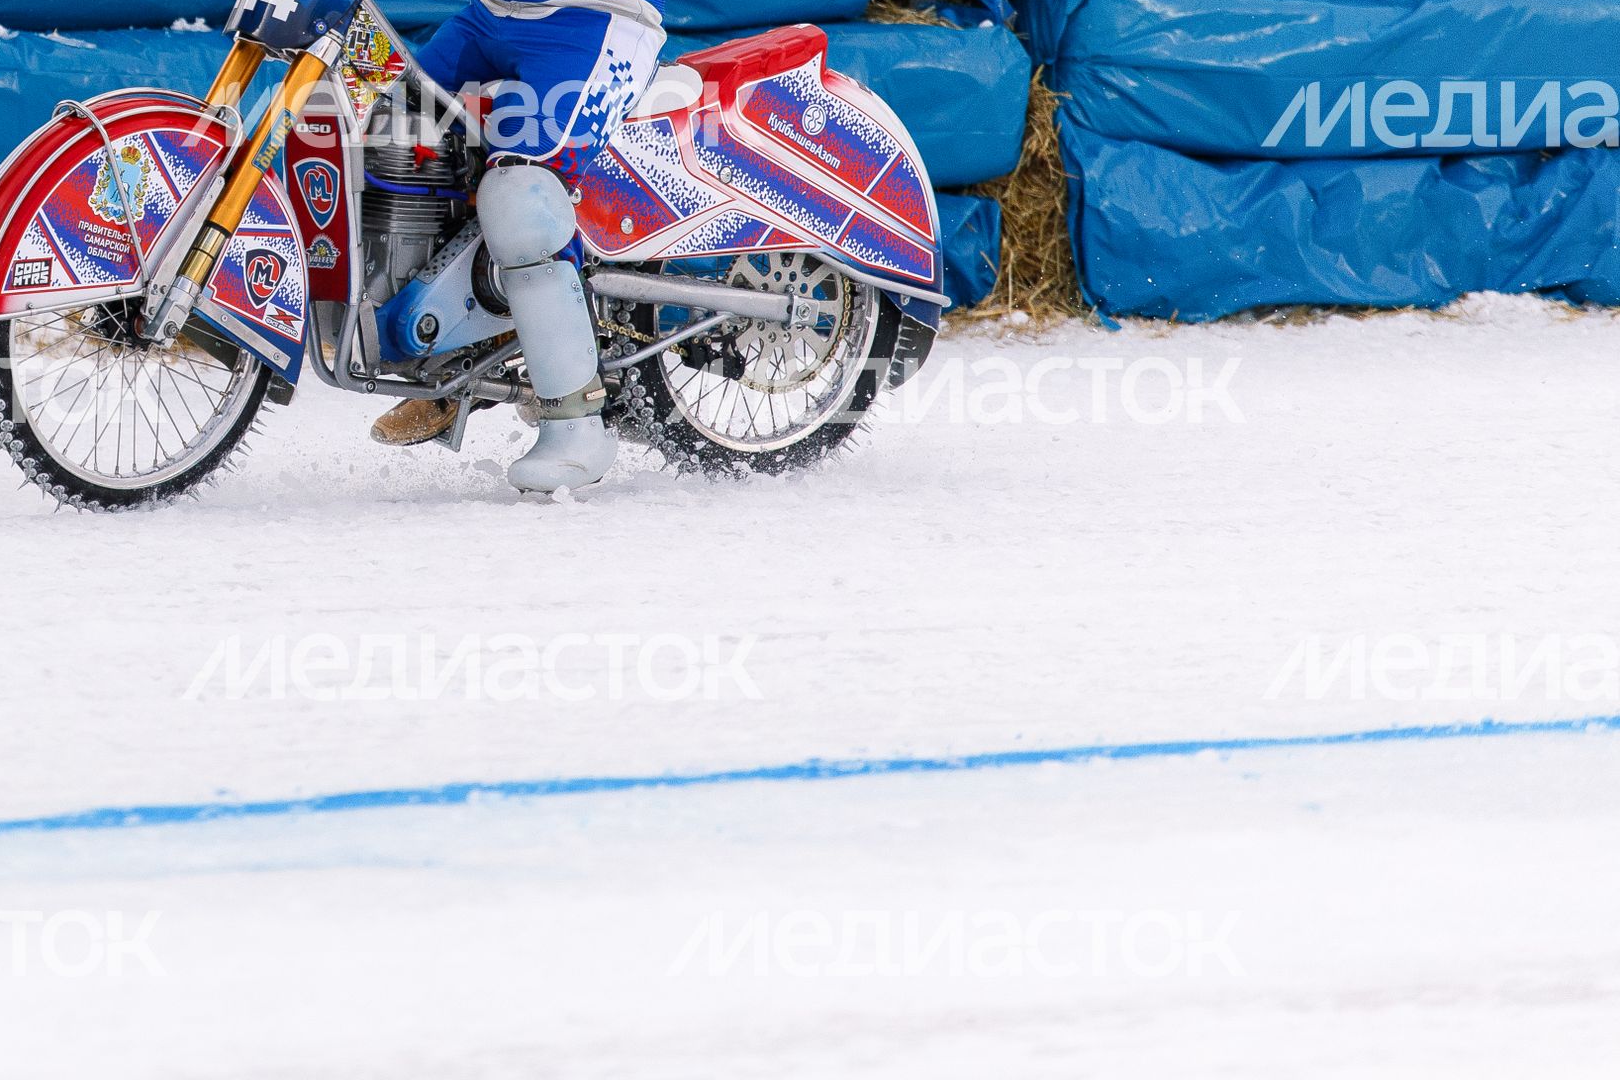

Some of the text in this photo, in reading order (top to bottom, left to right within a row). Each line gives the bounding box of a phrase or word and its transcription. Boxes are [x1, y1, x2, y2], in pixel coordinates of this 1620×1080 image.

[348, 30, 370, 50] 14
[256, 116, 293, 168] ÖHLINS
[767, 112, 841, 169] КуйбышевАзот
[84, 234, 130, 254] САМАРСКОЙ
[87, 246, 123, 263] ОБЛАСТИ
[14, 261, 49, 274] COOL
[13, 272, 49, 286] MTRS
